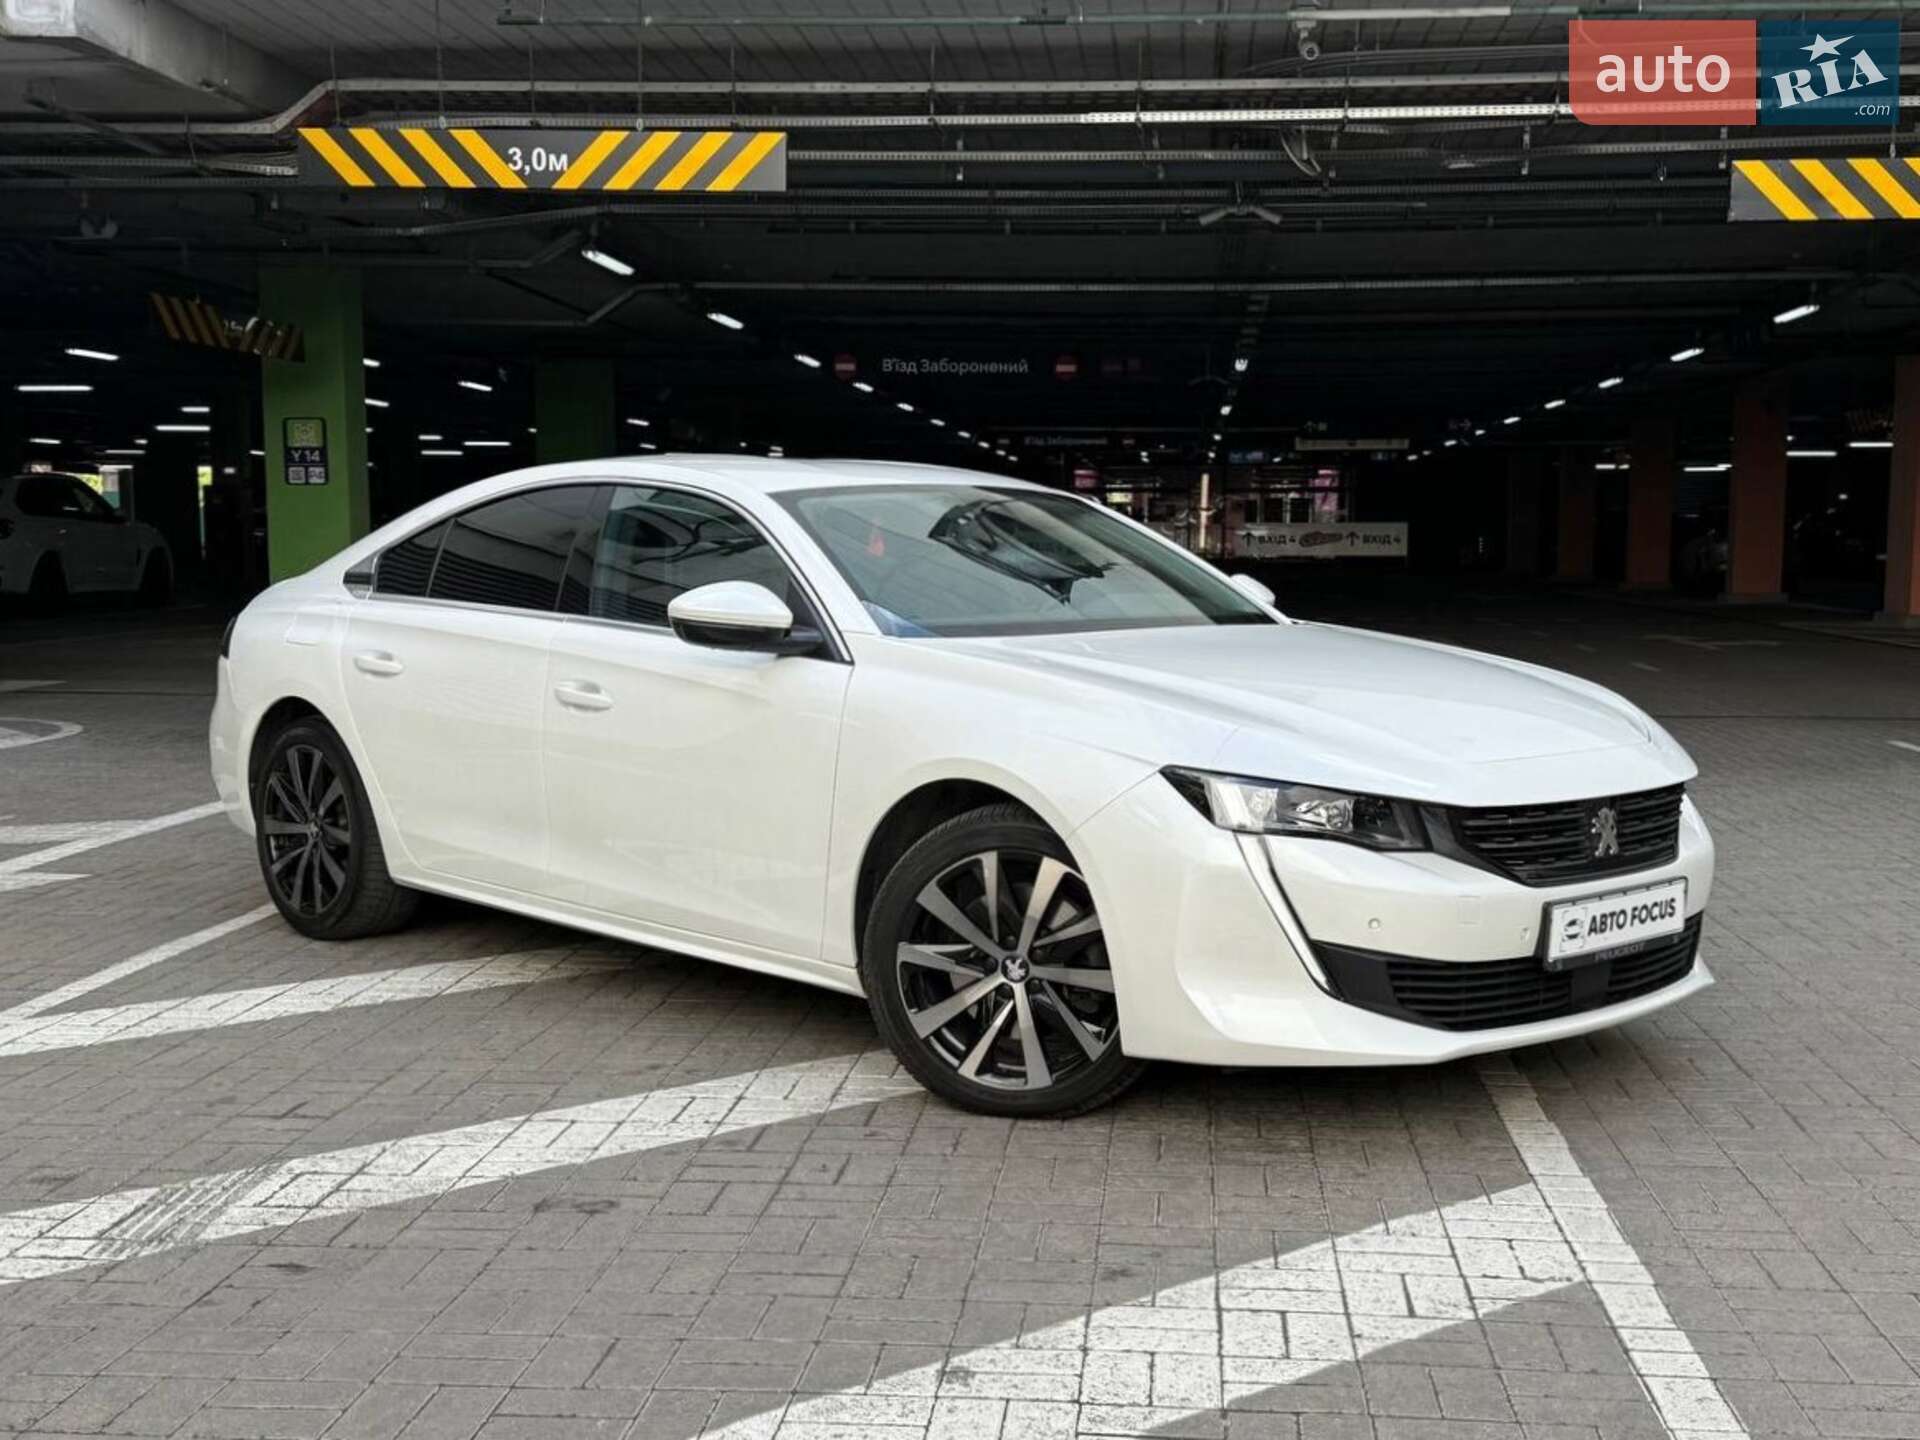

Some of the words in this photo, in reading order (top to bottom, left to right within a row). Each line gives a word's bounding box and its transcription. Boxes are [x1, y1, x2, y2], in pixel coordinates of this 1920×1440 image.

[507, 146, 569, 176] 3,0м
[920, 358, 1029, 376] Заборонений
[305, 450, 320, 462] 14
[1587, 909, 1628, 937] АВТО
[1630, 898, 1675, 926] FOCUS
